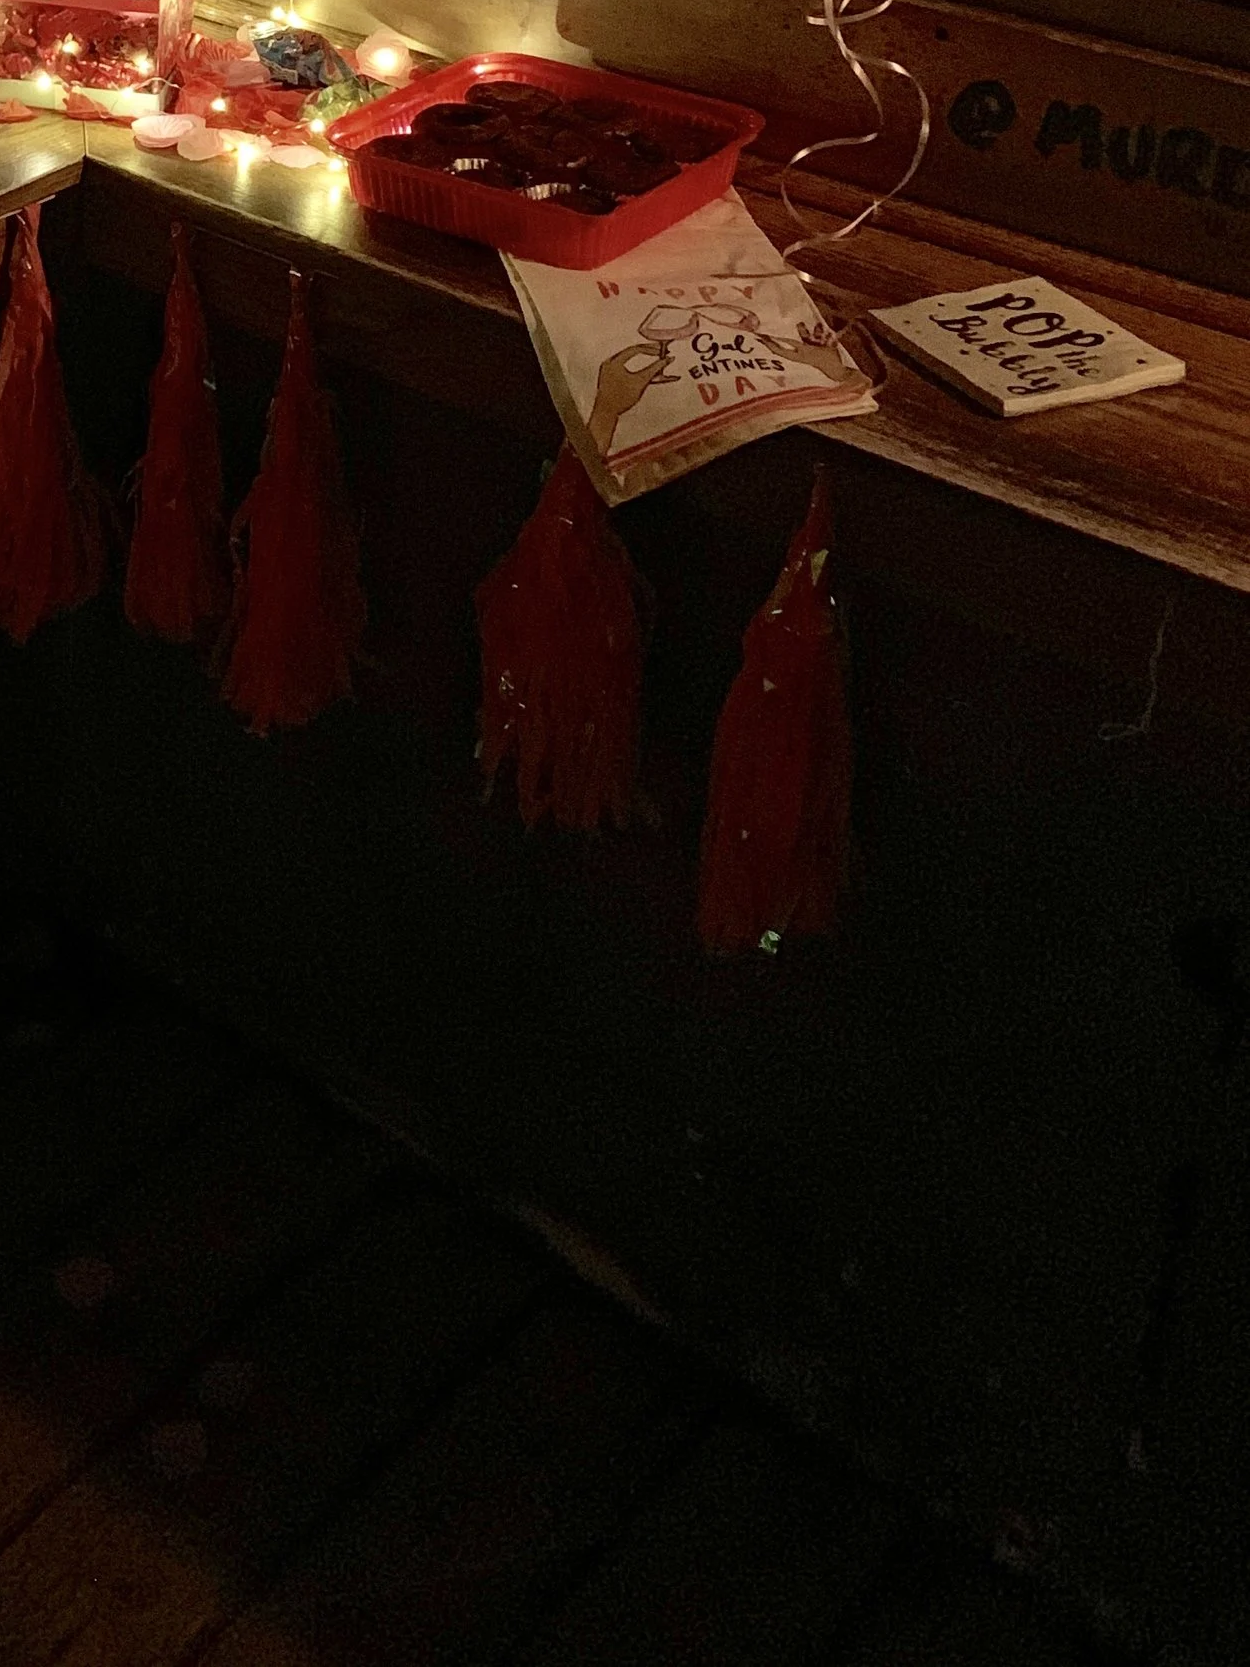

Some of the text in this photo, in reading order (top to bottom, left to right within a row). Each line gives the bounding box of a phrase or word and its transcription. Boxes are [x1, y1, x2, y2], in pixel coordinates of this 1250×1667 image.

[965, 292, 1105, 349] POP
[691, 332, 755, 362] Gal
[688, 357, 786, 381] ENTINES
[697, 374, 787, 406] DAY
